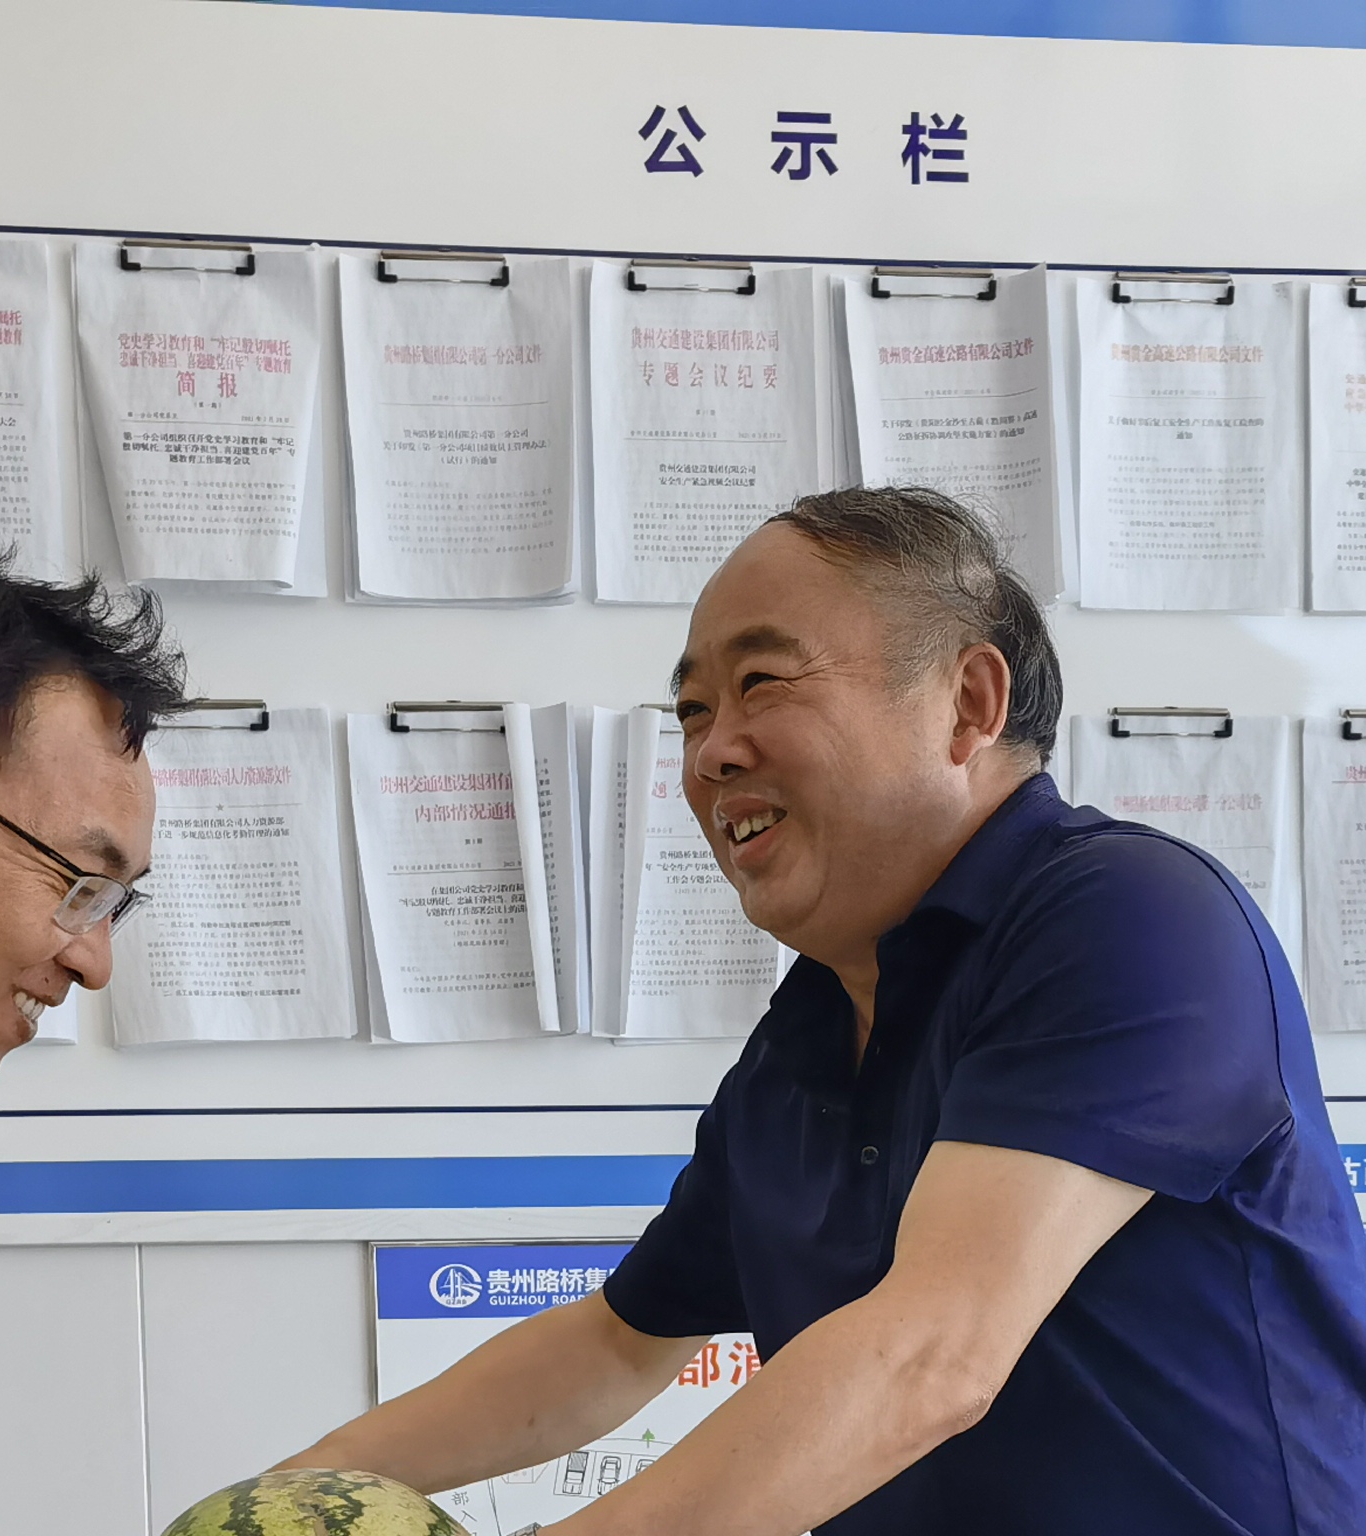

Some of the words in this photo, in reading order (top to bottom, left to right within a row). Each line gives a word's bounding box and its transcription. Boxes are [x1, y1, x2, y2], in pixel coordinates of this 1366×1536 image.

[637, 104, 970, 186] 公示栏
[631, 327, 780, 352] 贵州交通建设集团有限公司
[176, 371, 238, 398] 简报
[639, 360, 778, 390] 专题会议纪要
[153, 828, 291, 840] 于进一步规范信息化考勤管理的通知
[487, 1266, 616, 1295] 贵州路桥集
[489, 1294, 546, 1306] GUIZHOU
